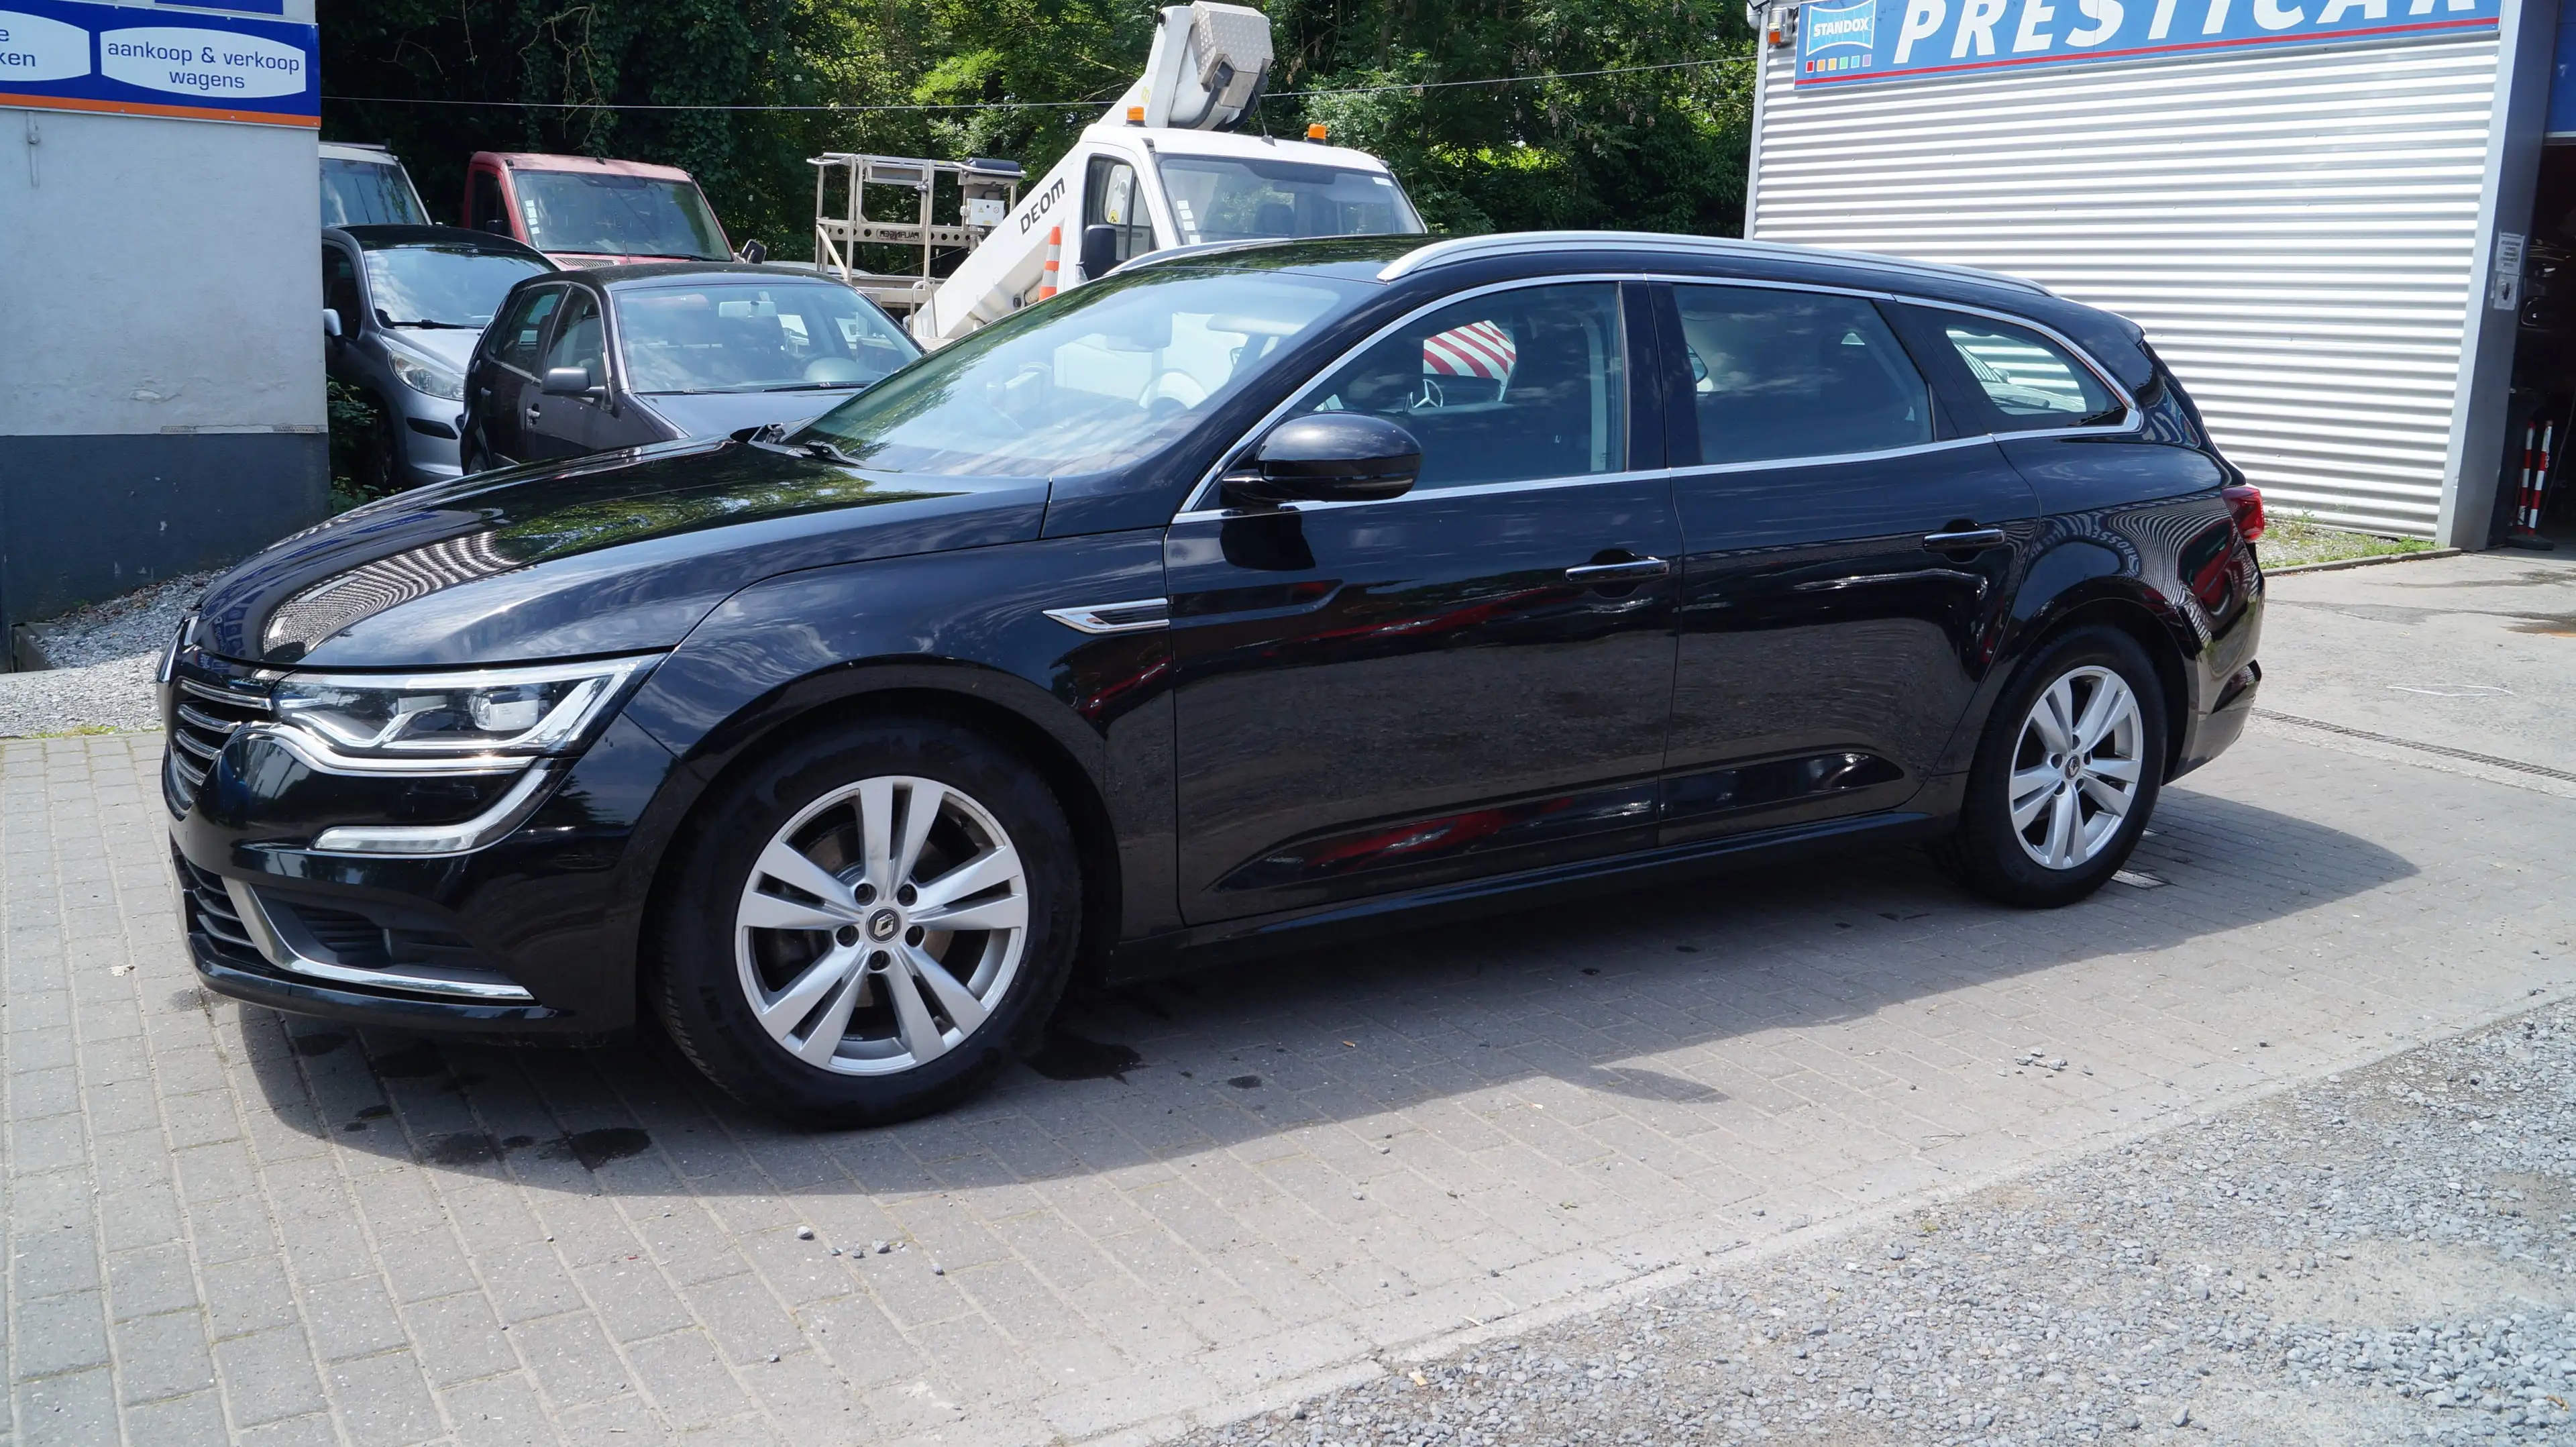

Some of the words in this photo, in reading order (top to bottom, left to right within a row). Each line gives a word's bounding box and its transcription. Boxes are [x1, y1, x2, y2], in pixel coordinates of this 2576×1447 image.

[1813, 16, 1872, 37] STANDOX
[108, 41, 193, 66] aankoop
[201, 46, 216, 64] &
[223, 51, 299, 75] verkoop
[169, 71, 245, 91] wagens
